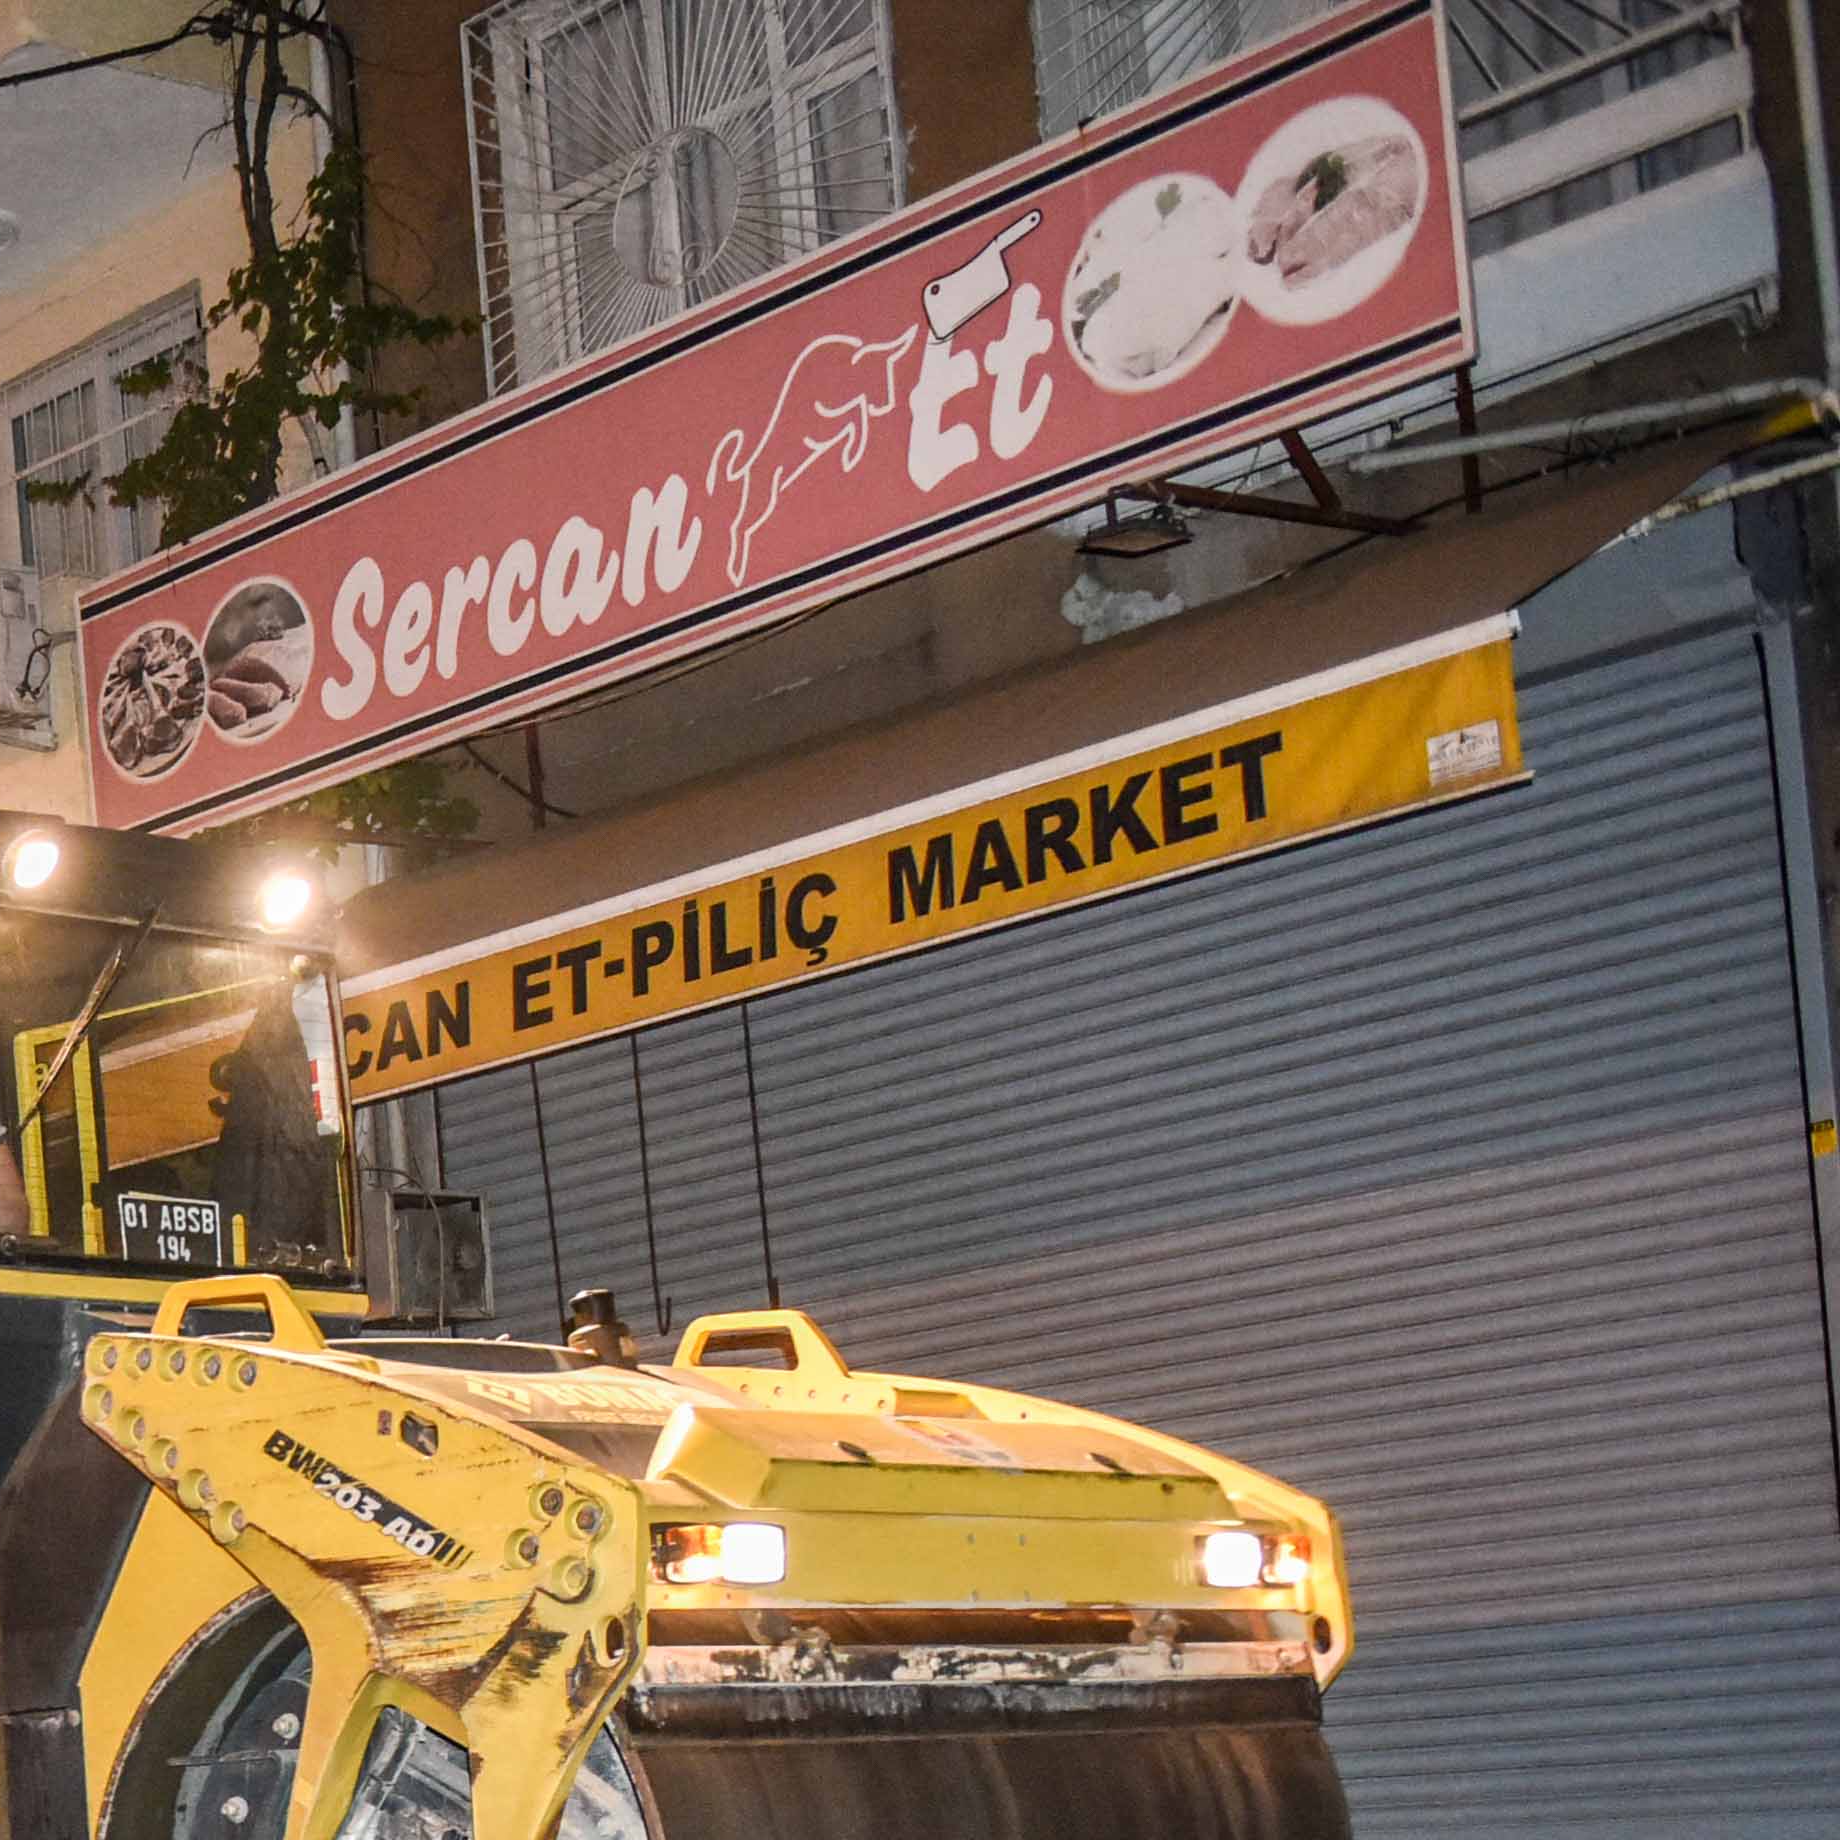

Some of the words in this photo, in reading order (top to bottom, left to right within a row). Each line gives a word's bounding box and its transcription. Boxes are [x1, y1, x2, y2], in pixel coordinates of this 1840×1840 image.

[321, 557, 702, 720] Sercan
[908, 283, 1054, 492] Et
[344, 980, 472, 1080] CAN
[512, 872, 839, 1032] ET-PİLİÇ
[887, 730, 1283, 925] MARKET
[124, 1203, 148, 1229] 01
[161, 1205, 215, 1235] ABSB
[157, 1234, 191, 1262] 194
[313, 1472, 382, 1522] 203
[382, 1516, 436, 1556] AD
